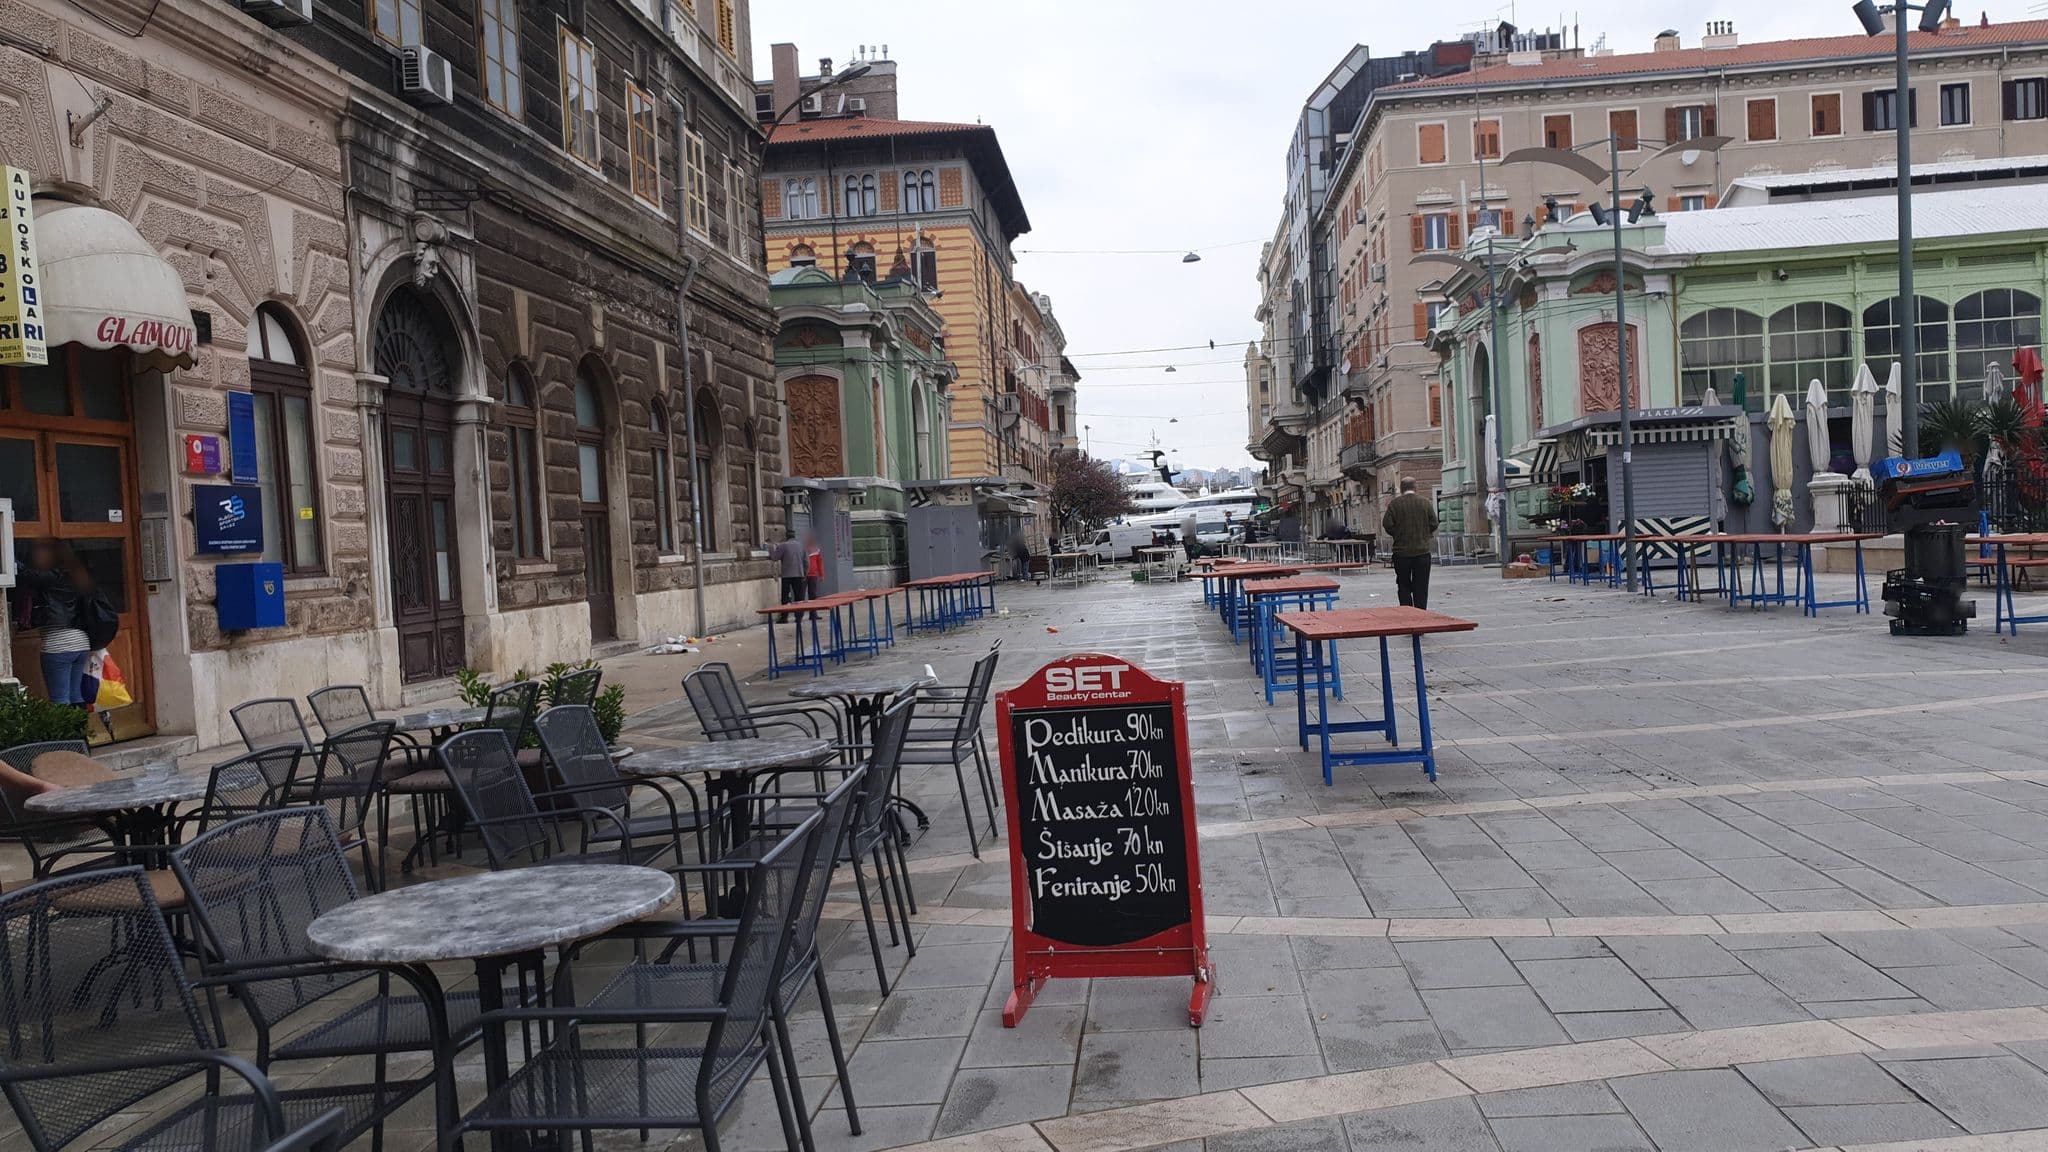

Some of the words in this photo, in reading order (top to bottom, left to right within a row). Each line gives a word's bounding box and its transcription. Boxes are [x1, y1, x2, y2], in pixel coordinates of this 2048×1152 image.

[97, 316, 194, 353] GLAMOUR
[1639, 409, 1678, 418] PLACA
[1046, 665, 1130, 692] SET
[1047, 692, 1089, 701] Beauty
[1091, 691, 1132, 699] centar
[1025, 716, 1126, 758] Pedikura
[1029, 751, 1129, 784] Manikura
[1031, 787, 1124, 822] Masaža
[1125, 787, 1170, 817] 120kn
[1038, 827, 1114, 865] Šišanje
[1117, 828, 1141, 856] 70
[1144, 825, 1164, 855] kn
[1035, 867, 1132, 901] Feniranje
